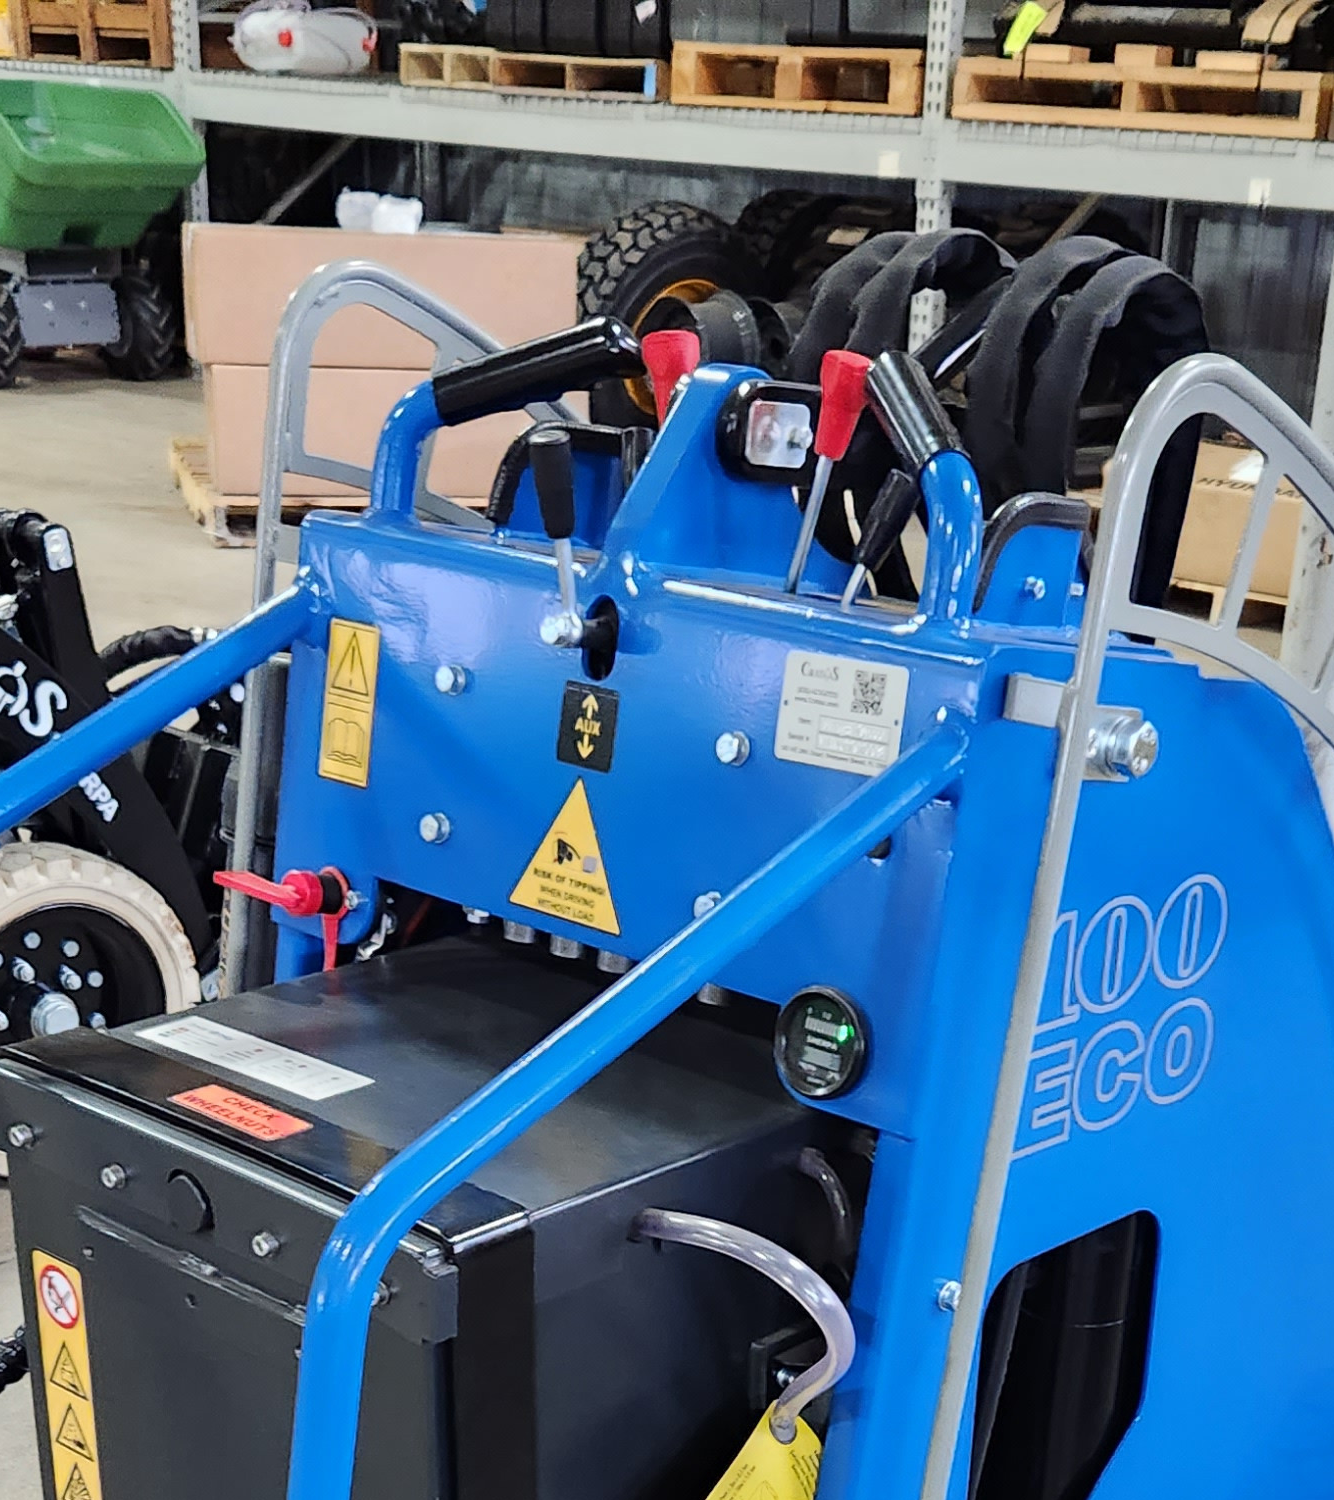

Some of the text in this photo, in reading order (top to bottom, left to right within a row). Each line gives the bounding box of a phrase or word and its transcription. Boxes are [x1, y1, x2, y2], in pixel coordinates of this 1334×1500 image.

[574, 716, 602, 737] AUX
[533, 866, 552, 881] RISK
[555, 872, 566, 885] OF
[571, 907, 595, 924] LOAD
[1035, 873, 1228, 1036] 100
[1009, 997, 1215, 1162] ECO
[182, 1093, 279, 1137] WHEELNUTS
[222, 1095, 282, 1122] CHECK
